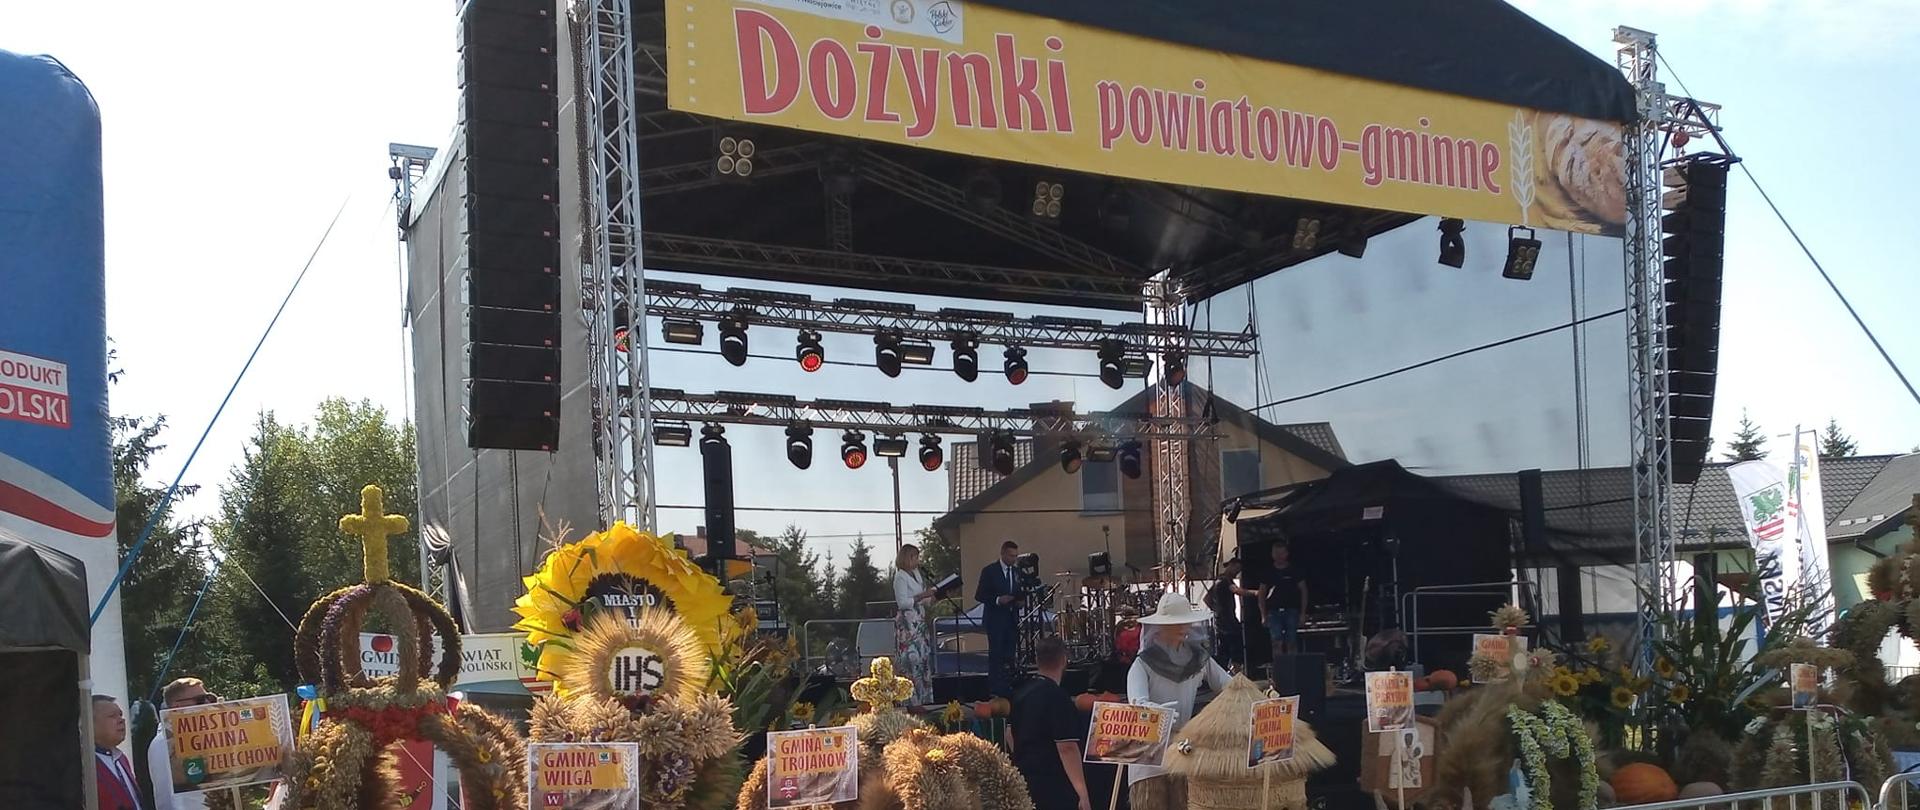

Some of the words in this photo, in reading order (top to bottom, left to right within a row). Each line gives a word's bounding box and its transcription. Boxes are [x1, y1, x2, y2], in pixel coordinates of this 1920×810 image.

[733, 8, 1074, 138] Dożynki
[1096, 79, 1501, 195] powiatowo-gminne
[0, 359, 62, 386] ODUKT
[0, 387, 67, 424] OLSKI
[603, 594, 655, 606] MIASTO
[461, 649, 502, 662] WIAT
[615, 655, 663, 691] IHS
[177, 711, 240, 734] MIASTO
[1102, 708, 1138, 723] GMINA
[1099, 723, 1150, 737] SOBOLEW
[178, 736, 184, 752] I
[190, 728, 249, 751] GMINA
[780, 737, 822, 754] GMINA
[544, 752, 597, 768] GMINA
[544, 770, 593, 786] WILGA
